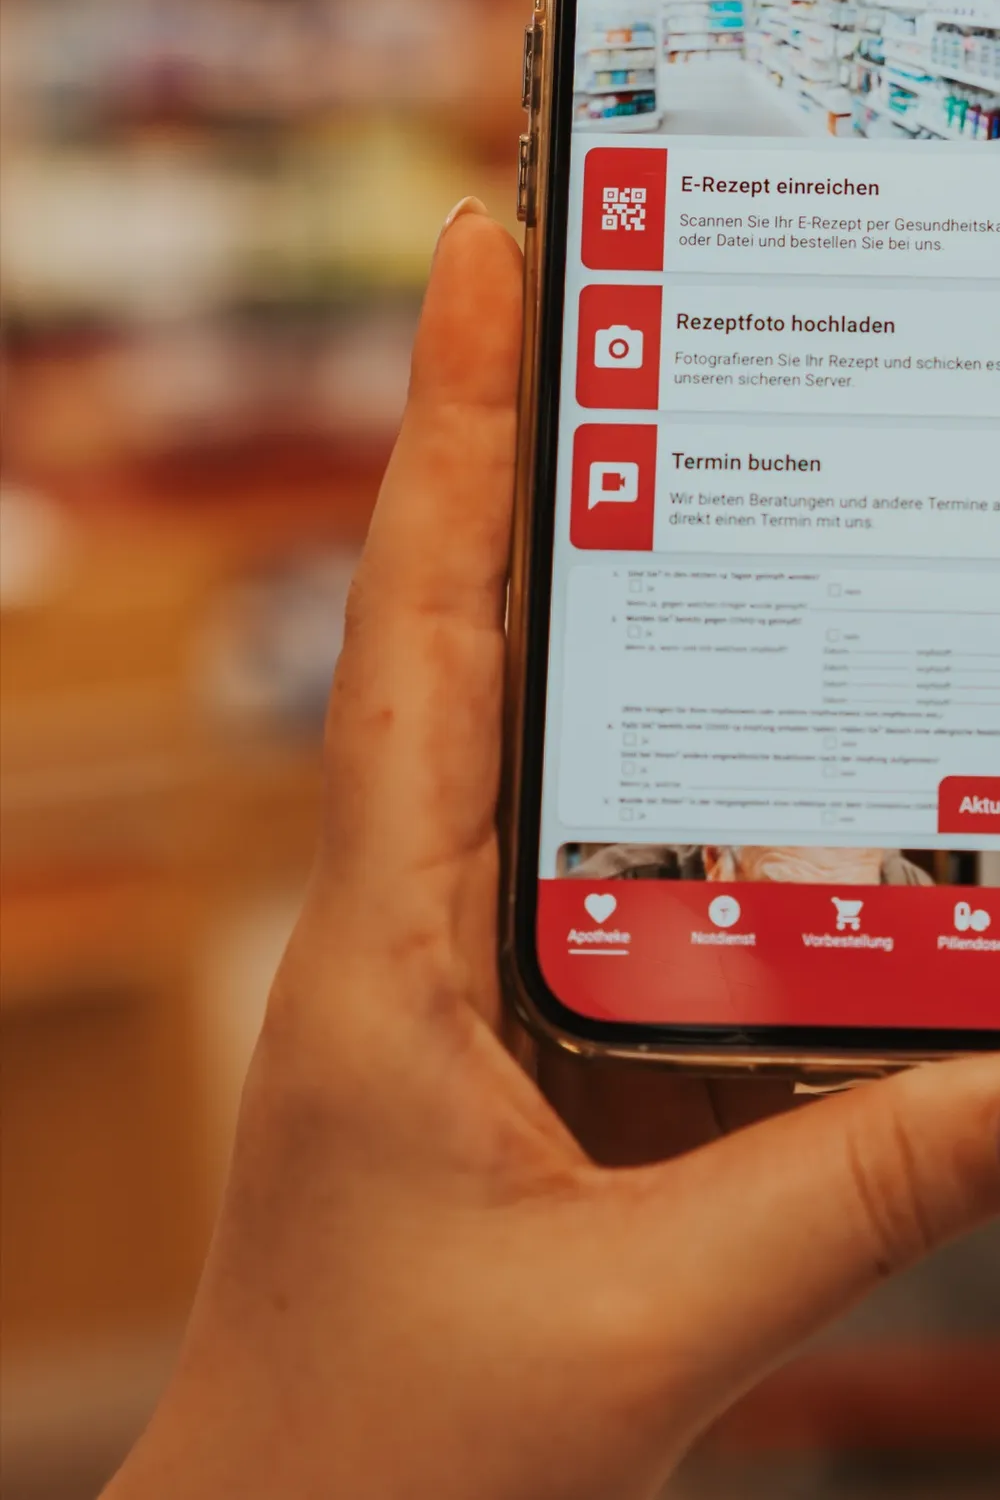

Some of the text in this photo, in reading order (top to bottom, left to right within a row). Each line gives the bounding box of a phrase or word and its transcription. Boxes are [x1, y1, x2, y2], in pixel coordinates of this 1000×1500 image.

[681, 175, 880, 197] E-Rezept einreichen
[679, 213, 742, 228] Scannen
[747, 214, 770, 229] Sie
[774, 215, 794, 229] Ihr
[798, 215, 862, 233] E-Rezept
[866, 219, 891, 233] per
[678, 232, 712, 247] oder
[716, 233, 754, 248] Datei
[758, 234, 786, 248] und
[790, 234, 857, 250] bestellen
[861, 235, 884, 250] Sie
[888, 236, 910, 251] bei
[676, 312, 895, 335] Rezeptfoto hochladen
[674, 351, 774, 369] Fotografieren
[777, 353, 801, 368] Sie
[805, 353, 824, 367] Ihr
[828, 354, 879, 371] Rezept
[883, 355, 912, 370] und
[916, 356, 982, 371] schicken
[673, 374, 734, 385] unseren
[738, 372, 801, 387] sicheren
[671, 452, 821, 472] Termin buchen
[669, 491, 694, 505] Wir
[698, 492, 745, 506] bieten
[749, 492, 835, 512] Beratungen
[839, 495, 868, 510] und
[872, 496, 924, 511] andere
[928, 496, 989, 512] Termine
[668, 512, 711, 526] direkt
[714, 515, 756, 526] einen
[760, 512, 812, 527] Termin
[815, 516, 841, 528] mit
